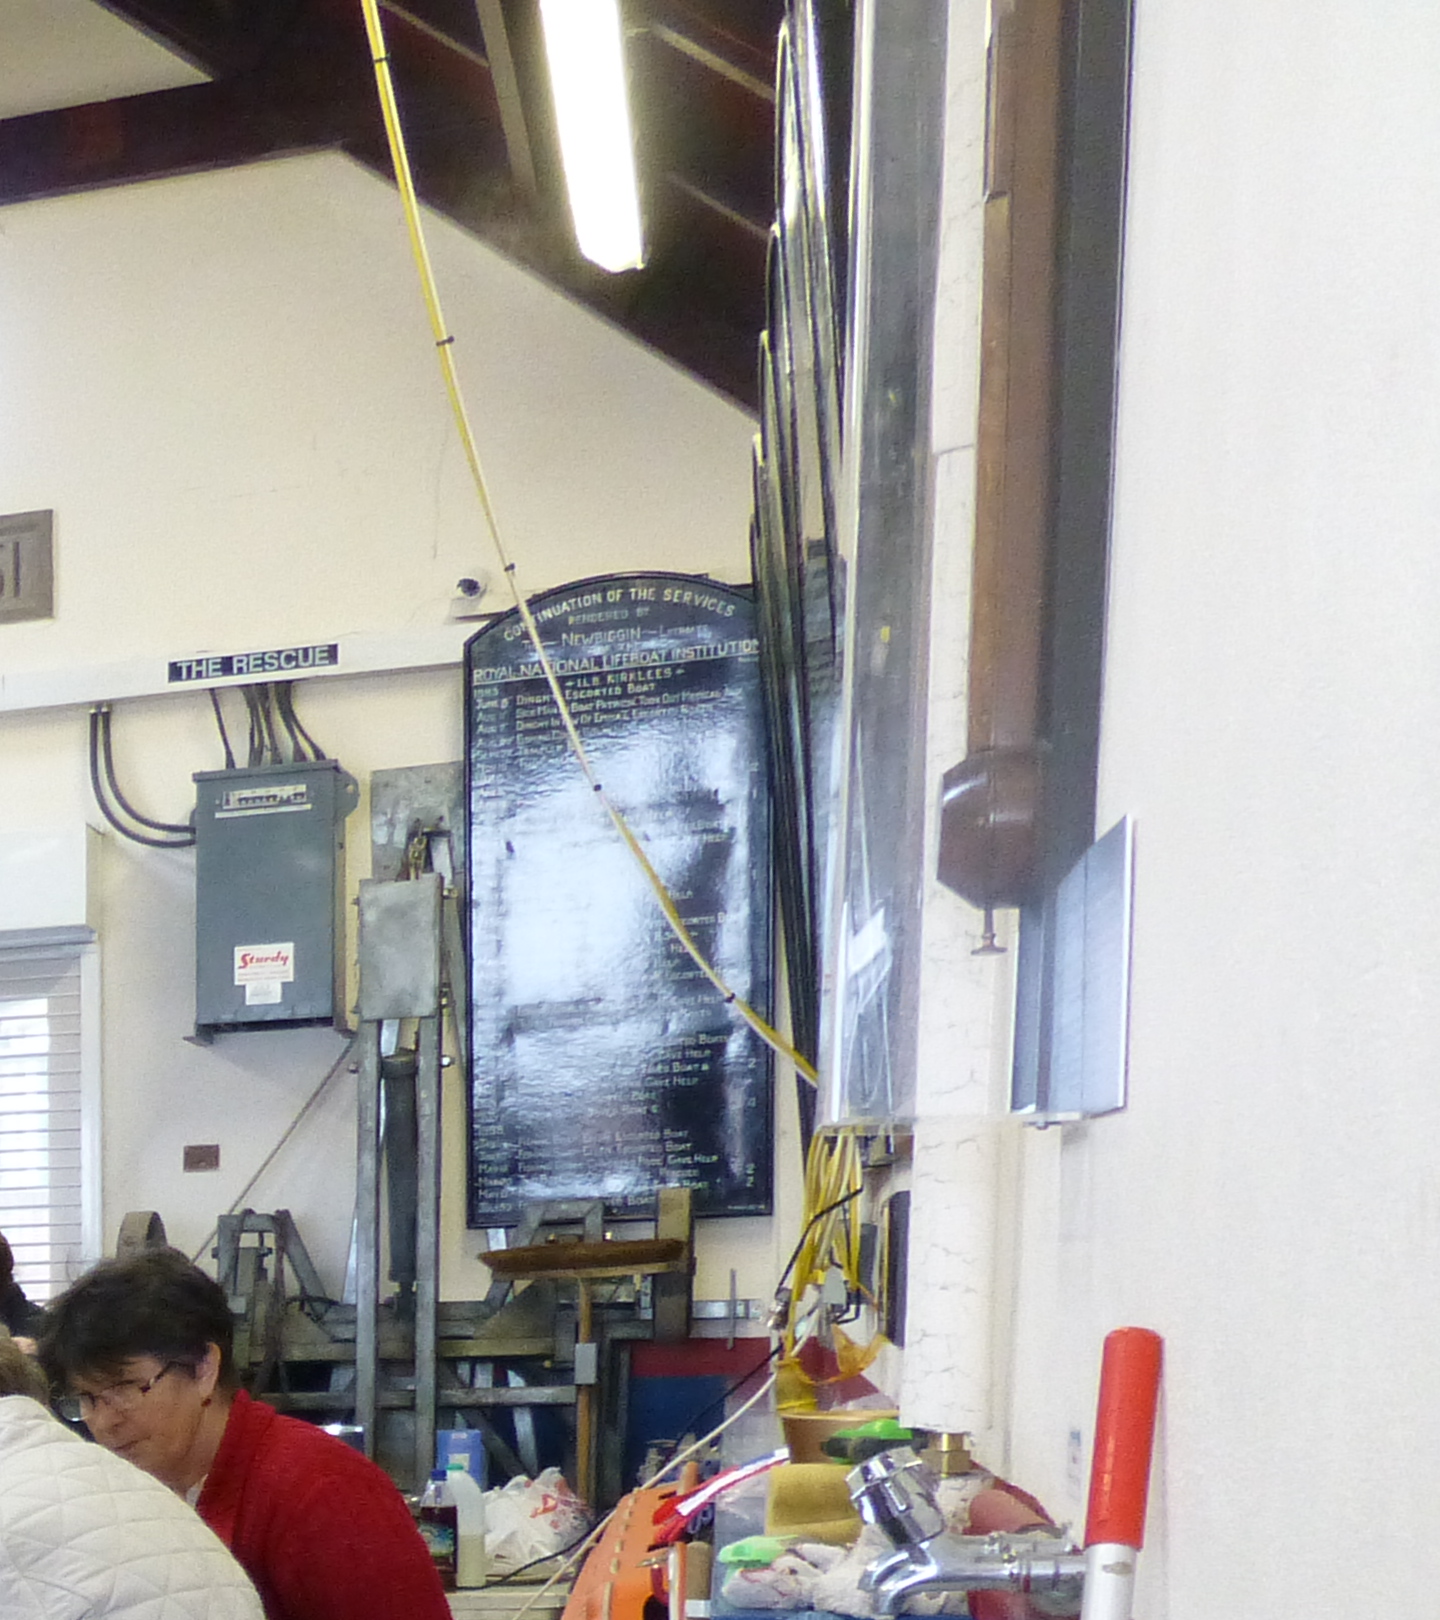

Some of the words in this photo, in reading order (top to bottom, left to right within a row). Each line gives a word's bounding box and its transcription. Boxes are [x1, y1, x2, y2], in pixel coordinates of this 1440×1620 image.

[606, 588, 624, 603] OF
[629, 586, 656, 601] THE
[663, 587, 737, 619] SERVICES
[561, 626, 642, 647] NEWBIGGIN
[177, 658, 222, 680] THE
[232, 646, 329, 675] RESCUE
[238, 951, 289, 969] Sturdy
